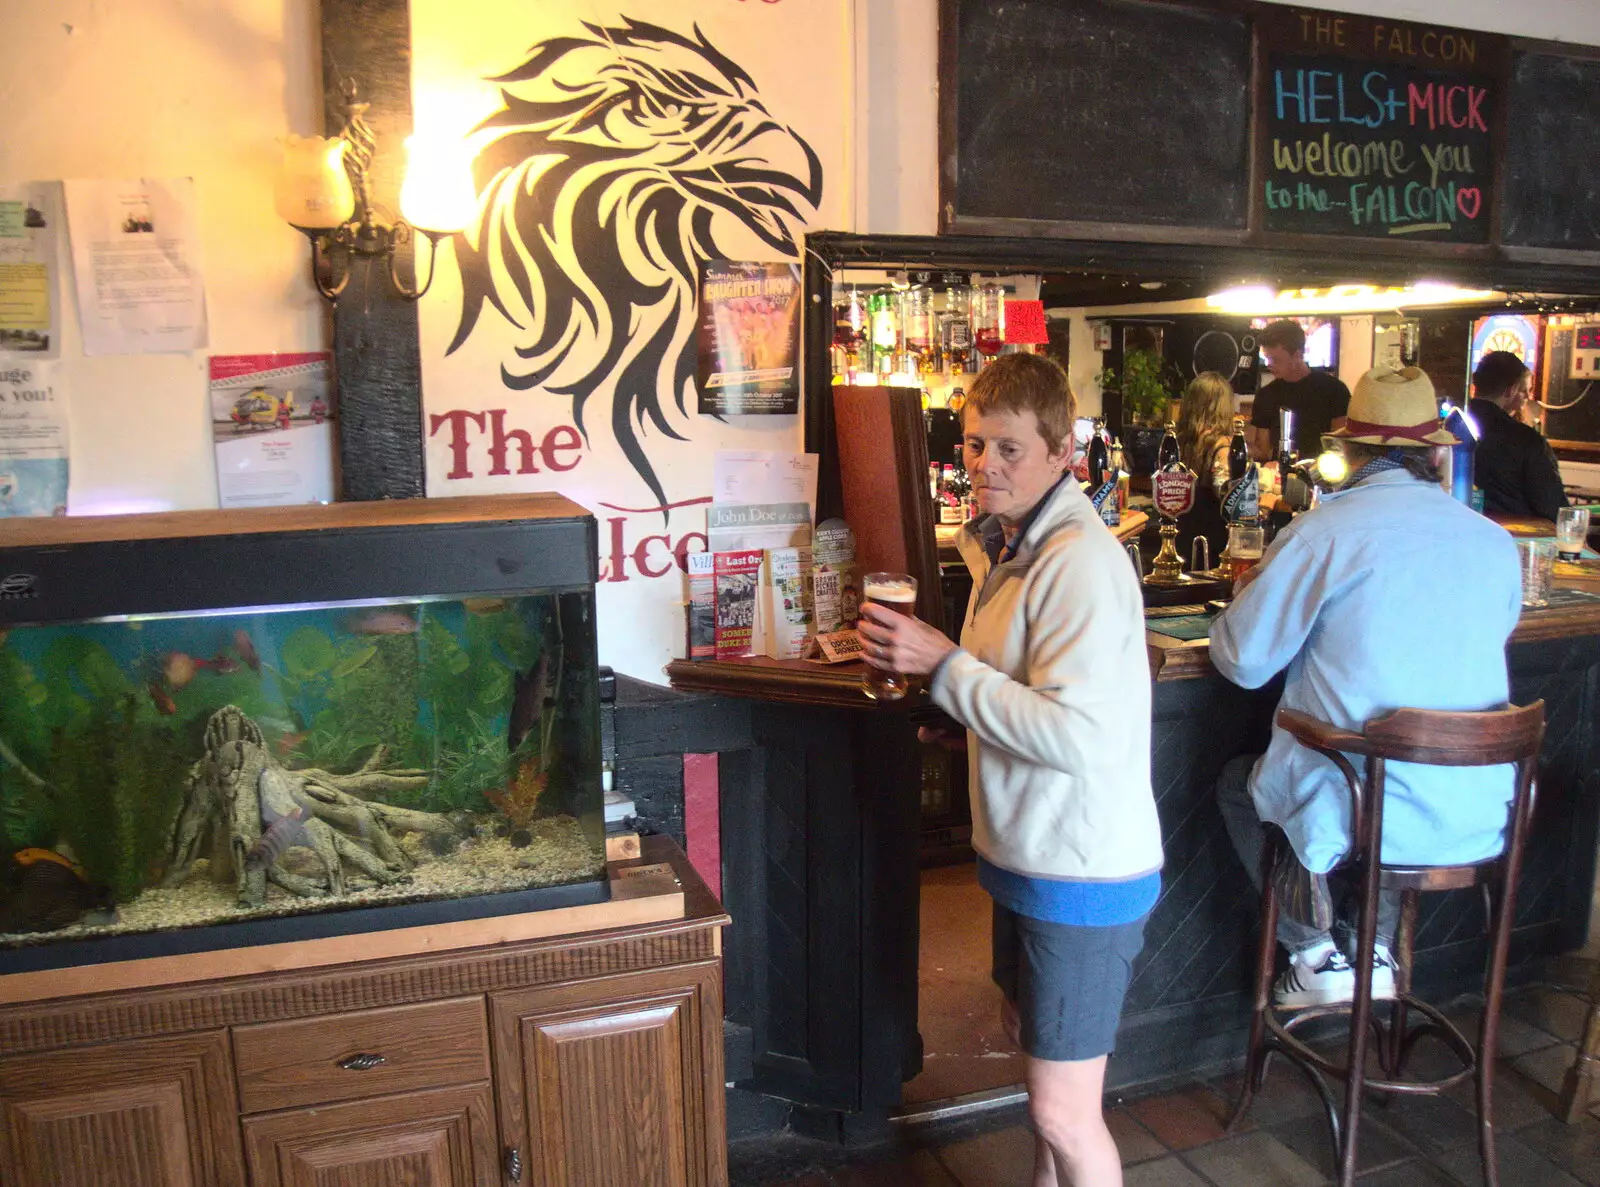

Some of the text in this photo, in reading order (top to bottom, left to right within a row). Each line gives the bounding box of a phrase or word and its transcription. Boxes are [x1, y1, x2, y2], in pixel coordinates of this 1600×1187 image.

[1300, 15, 1477, 64] THE FALCON
[1408, 82, 1488, 133] MICK
[1273, 132, 1475, 190] welcome you
[1265, 179, 1293, 209] to
[1350, 180, 1462, 226] FALCON
[705, 269, 743, 280] Summer
[0, 368, 32, 385] uge
[12, 386, 54, 406] you!
[430, 408, 583, 480] The
[1093, 480, 1114, 509] DNAMS
[1158, 480, 1191, 490] LONDON
[1224, 478, 1250, 514] ADNAMS
[714, 510, 746, 526] John
[749, 507, 777, 521] Doe
[692, 556, 714, 569] Vill
[726, 556, 746, 566] Last
[722, 629, 752, 638] SOMER
[718, 640, 741, 648] DUKE
[834, 645, 863, 655] PIONEE
